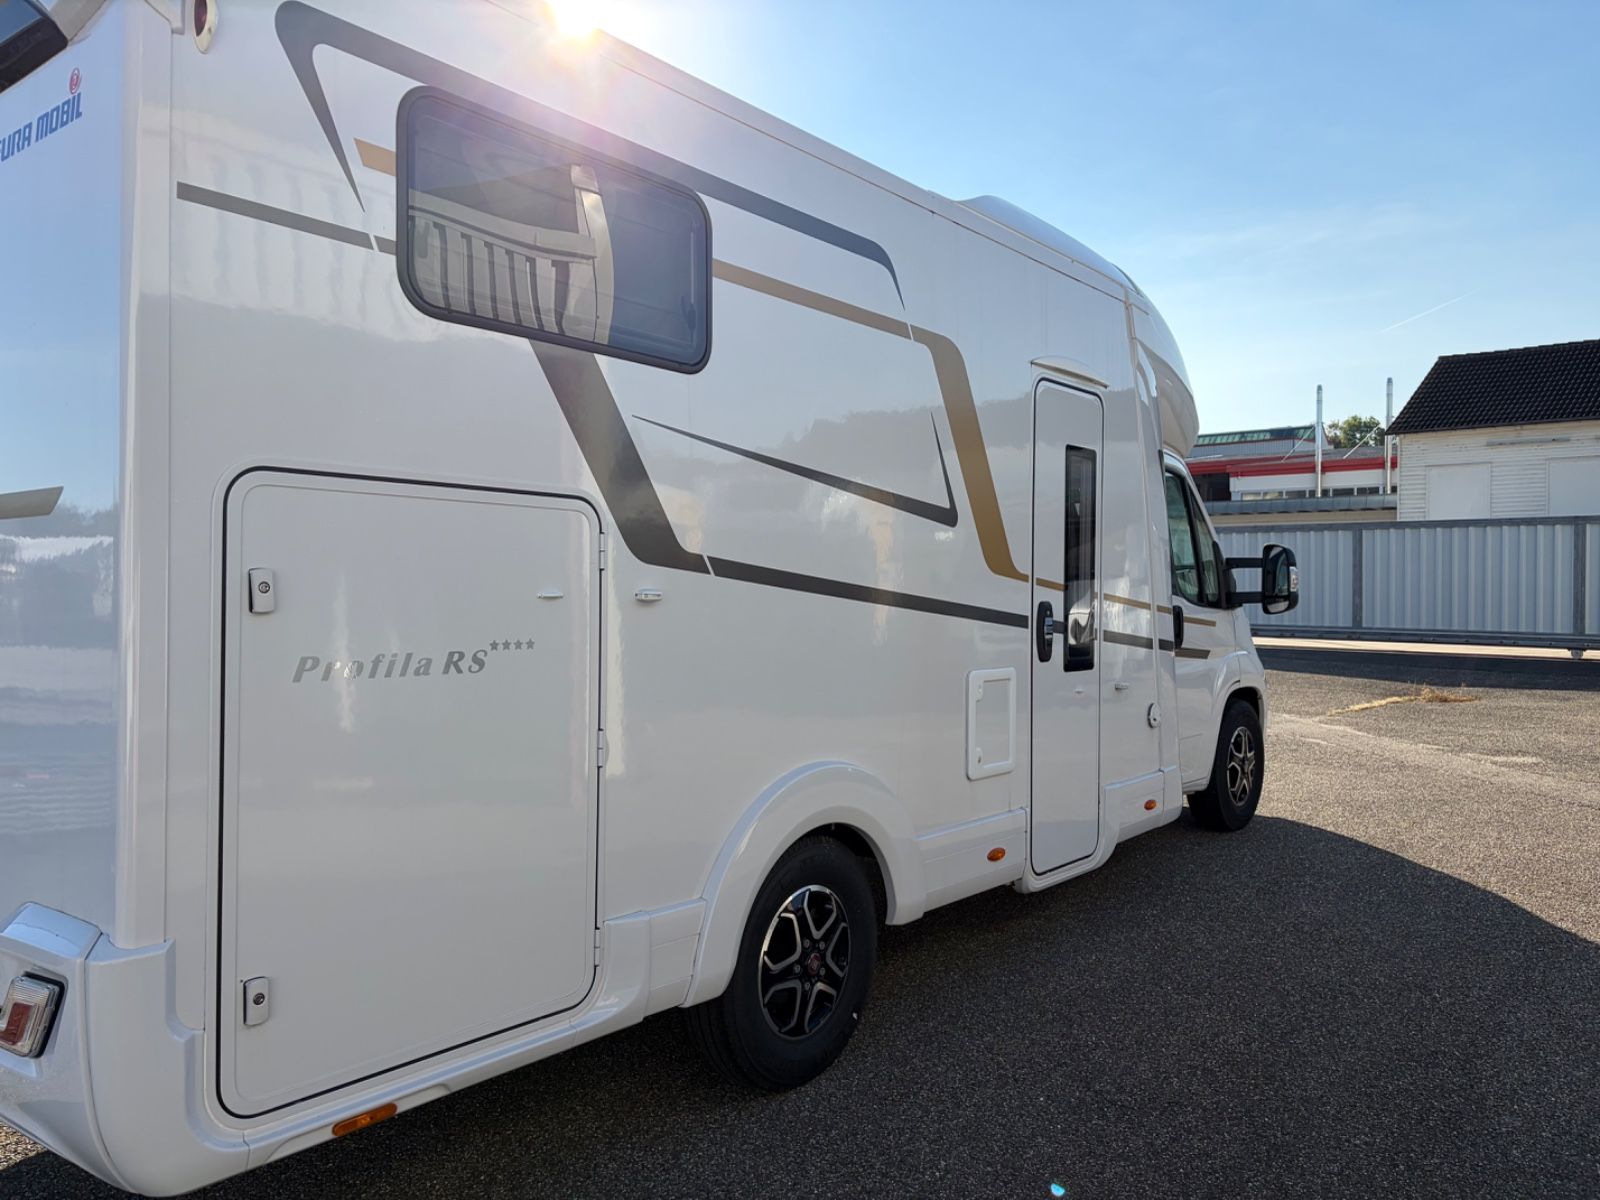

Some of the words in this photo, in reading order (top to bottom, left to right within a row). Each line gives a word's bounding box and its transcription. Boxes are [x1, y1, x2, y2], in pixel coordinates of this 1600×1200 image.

[0, 121, 33, 162] URA
[36, 91, 82, 142] MOBIL
[292, 652, 433, 683] Profila
[442, 649, 488, 675] RS
